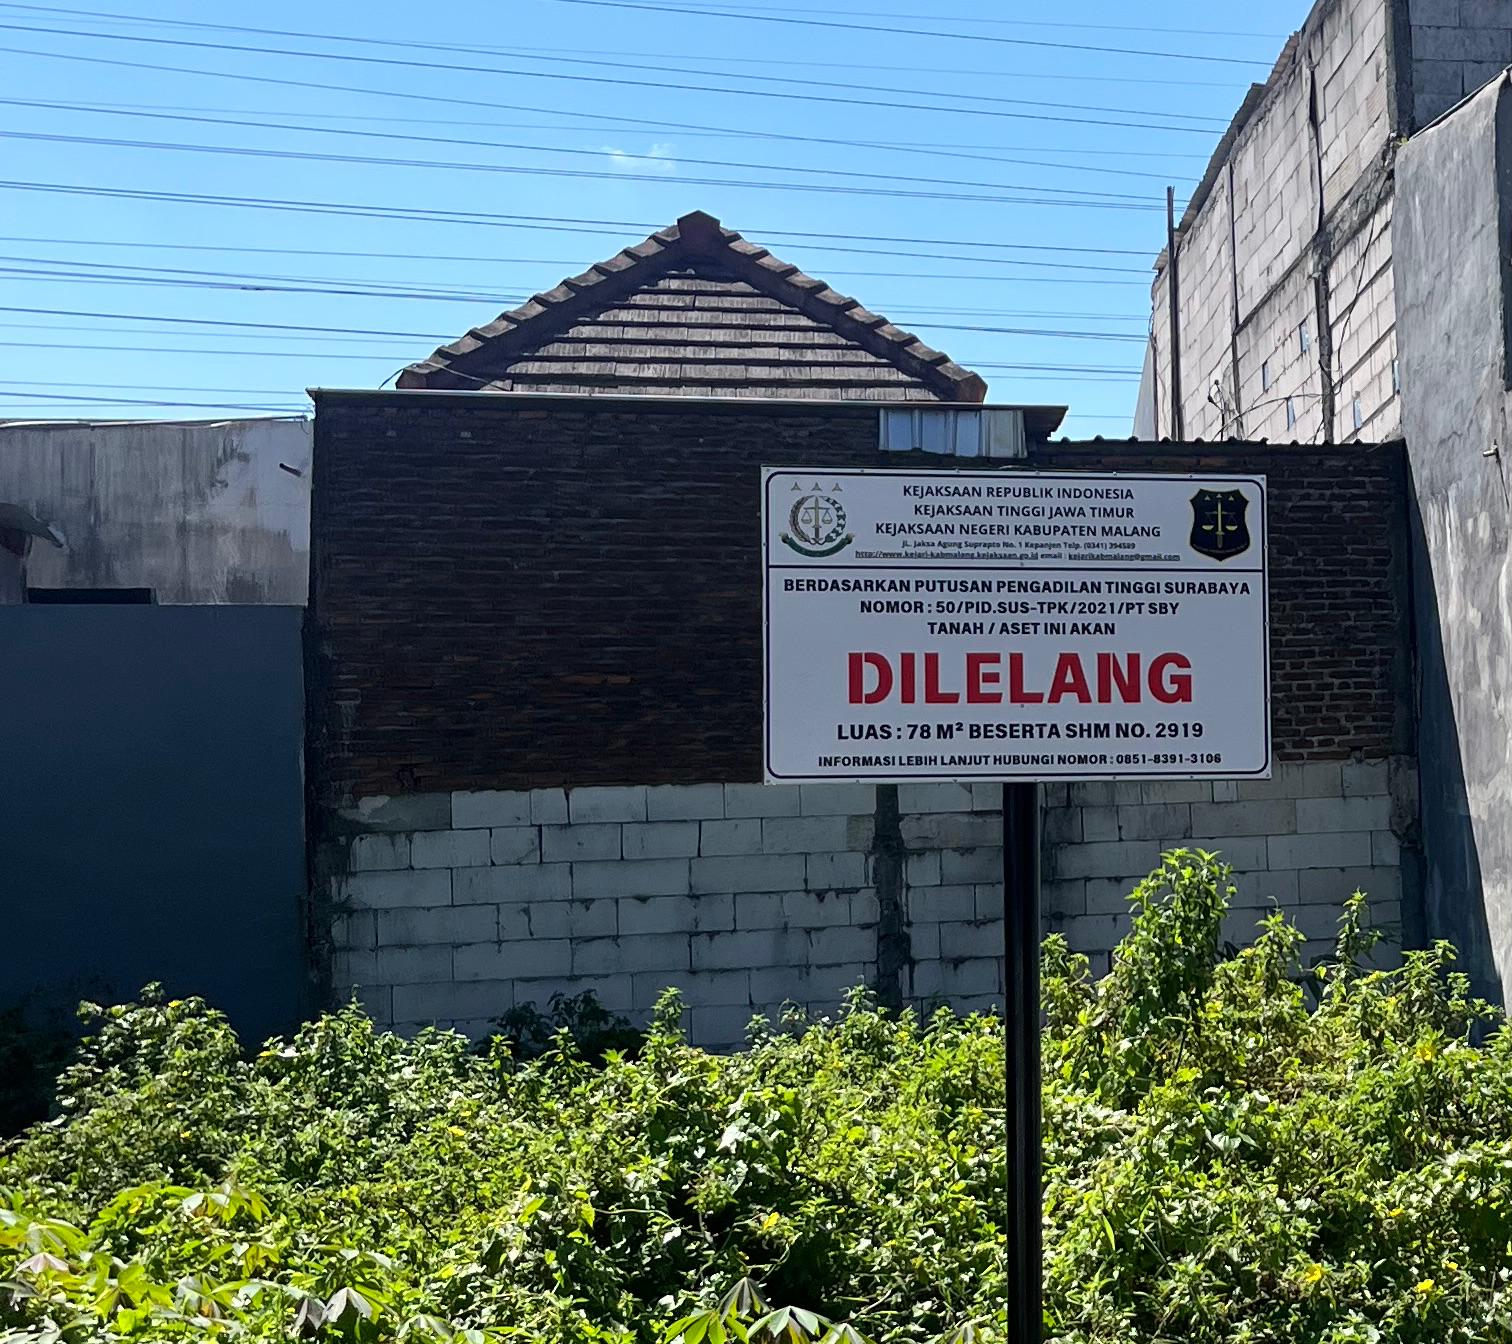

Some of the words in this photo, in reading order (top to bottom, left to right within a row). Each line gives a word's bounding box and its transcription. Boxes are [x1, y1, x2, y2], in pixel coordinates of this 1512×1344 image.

[903, 485, 982, 500] KEJAKSAAN
[986, 486, 1053, 499] REPUBLIK
[1057, 487, 1134, 500] INDONESIA
[914, 504, 993, 519] KEJAKSAAN
[996, 505, 1045, 517] TINGGI
[1047, 506, 1086, 520] JAWA
[1089, 506, 1134, 519] TIMUR
[875, 522, 954, 537] KEJAKSAAN
[959, 523, 1009, 536] NEGERI
[1014, 524, 1097, 537] KABUPATEN
[1100, 525, 1160, 537] MALANG
[913, 539, 935, 549] Jaksa
[936, 540, 963, 550] Agung
[964, 540, 1001, 550] Suprapto
[1002, 540, 1016, 549] No.
[1062, 541, 1082, 551] Telp.
[1040, 551, 1062, 559] email
[783, 578, 910, 593] BERDASARKAN
[914, 579, 992, 593] PUTUSAN
[996, 580, 1101, 594] PENGADILAN
[1104, 580, 1160, 594] TINGGI
[1163, 581, 1250, 595] SURABAYA
[860, 600, 924, 614] NOMOR
[935, 600, 1145, 615] 50/PID.SUS-TPK/2021/PT
[1148, 601, 1179, 615] SBY
[926, 621, 984, 635] TANAH
[987, 621, 995, 635] /
[998, 621, 1041, 635] ASET
[1043, 621, 1066, 635] INI
[1069, 622, 1115, 635] AKAN
[848, 652, 1192, 704] DILELANG
[837, 723, 892, 740] LUAS
[906, 723, 931, 740] 78
[968, 723, 1061, 739] BESERTA
[1065, 722, 1110, 739] SHM
[1115, 722, 1150, 739] NO.
[1155, 722, 1203, 738] 2919
[818, 755, 896, 767] INFORMASI
[898, 755, 937, 767] LEBIH
[940, 754, 991, 766] LANJUT
[993, 754, 1054, 766] HUBUNGI
[1057, 753, 1107, 765] NOMOR
